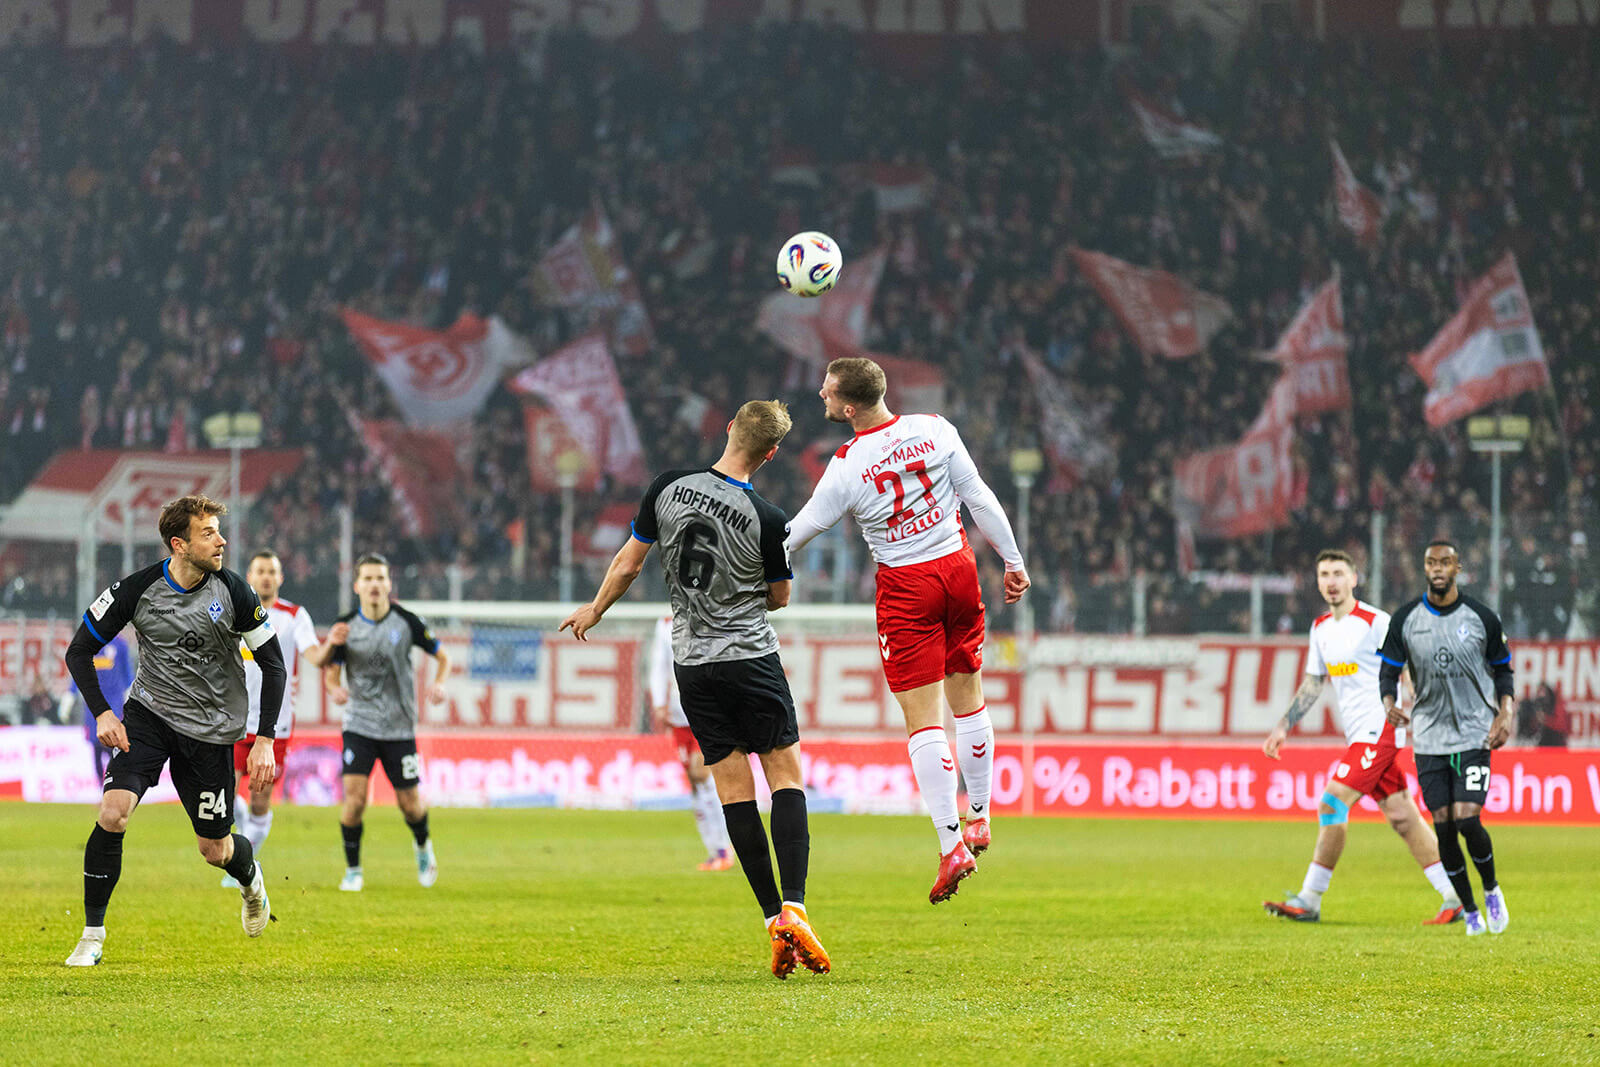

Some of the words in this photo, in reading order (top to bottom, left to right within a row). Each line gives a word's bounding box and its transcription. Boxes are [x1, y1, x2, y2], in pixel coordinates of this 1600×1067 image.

[672, 485, 752, 533] HOFFMANN
[886, 506, 944, 543] Netto
[680, 522, 719, 590] 6
[418, 749, 592, 802] ngebot
[1103, 757, 1255, 808] Rabatt
[1465, 765, 1491, 792] 27
[198, 788, 227, 820] 24
